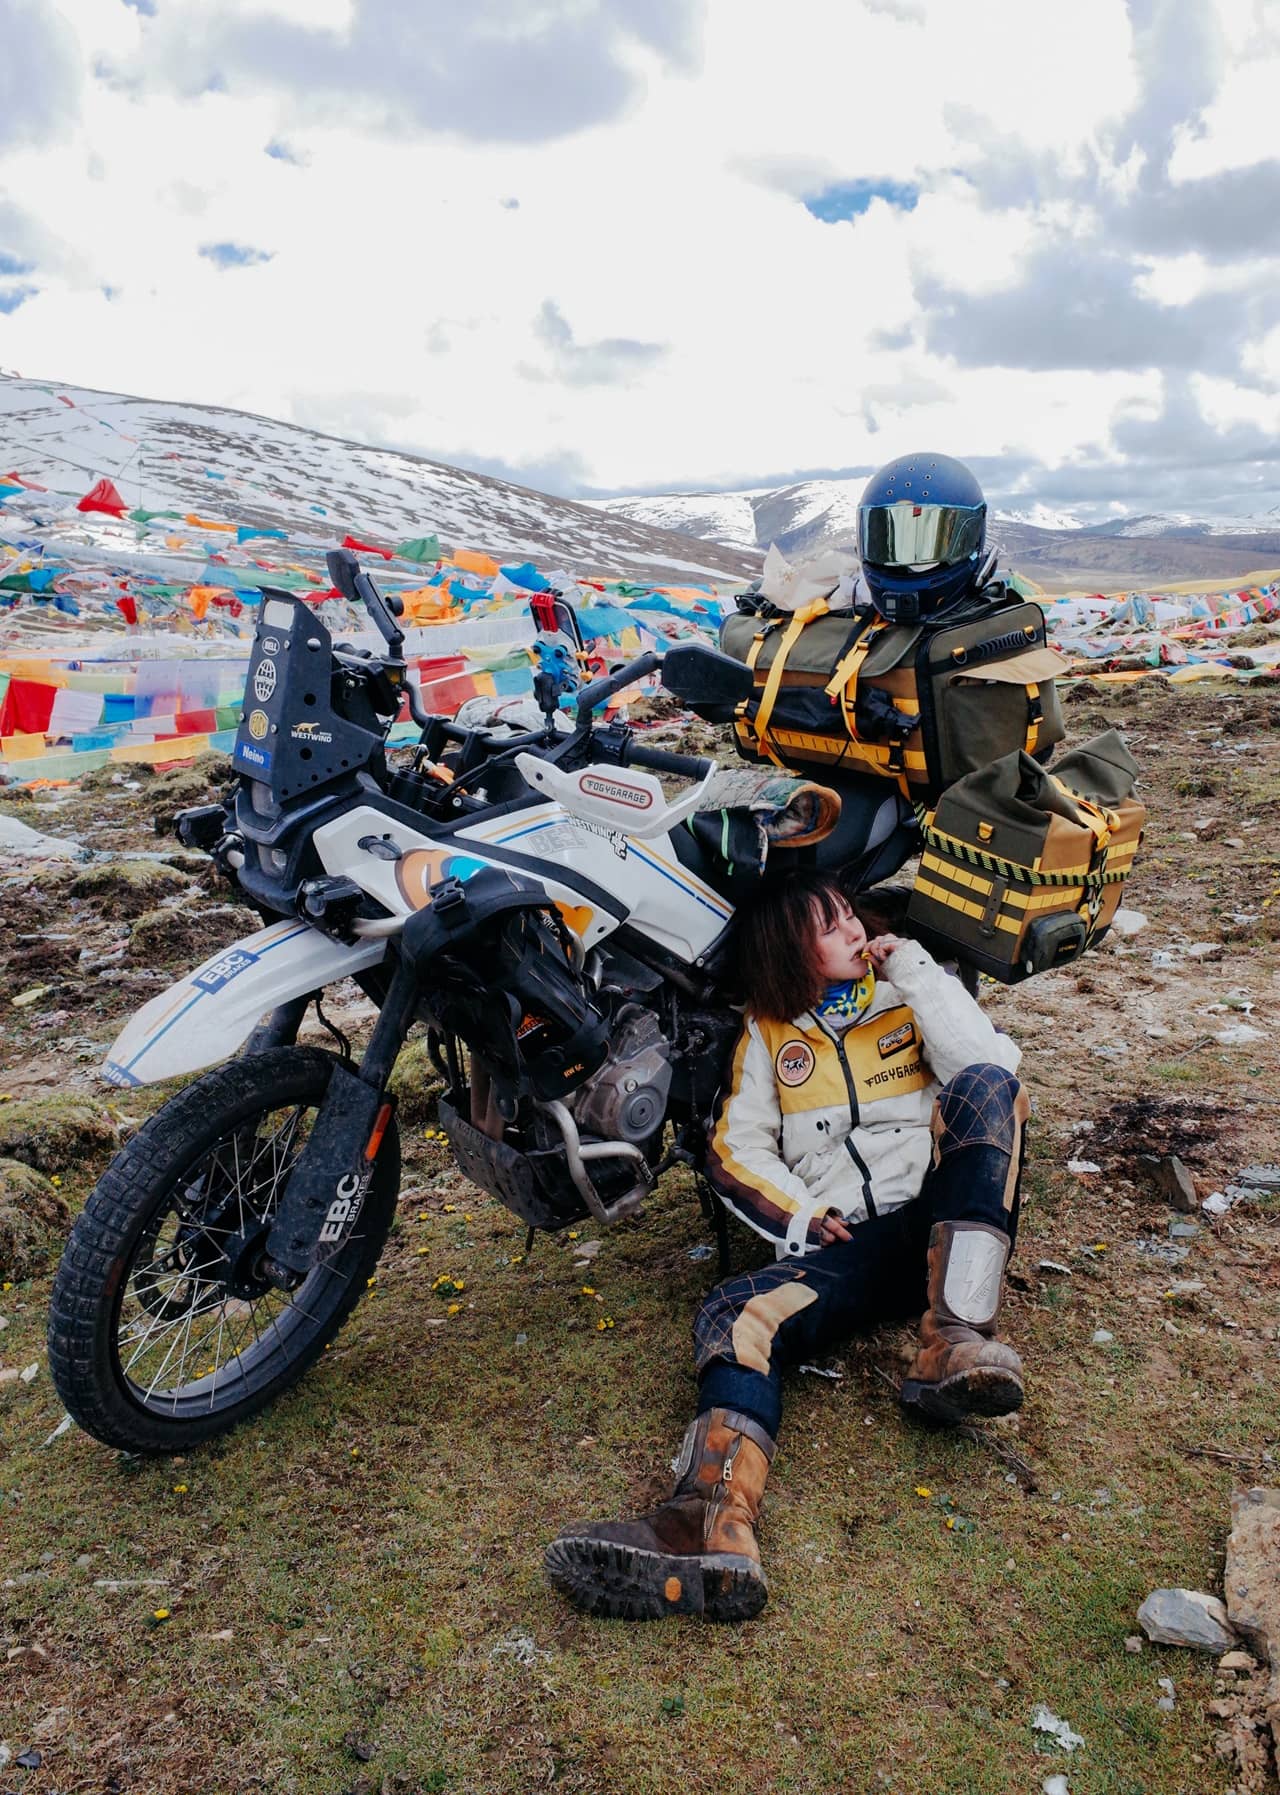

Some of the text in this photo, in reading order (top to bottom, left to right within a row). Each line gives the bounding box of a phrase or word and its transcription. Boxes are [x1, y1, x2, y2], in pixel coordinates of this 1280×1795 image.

[291, 731, 332, 743] WESTWIND
[242, 743, 265, 765] Neino
[586, 780, 647, 804] FOGYGARAGE
[199, 953, 245, 985] EBC
[318, 1174, 360, 1242] EBC
[346, 1175, 370, 1222] BRAKES
